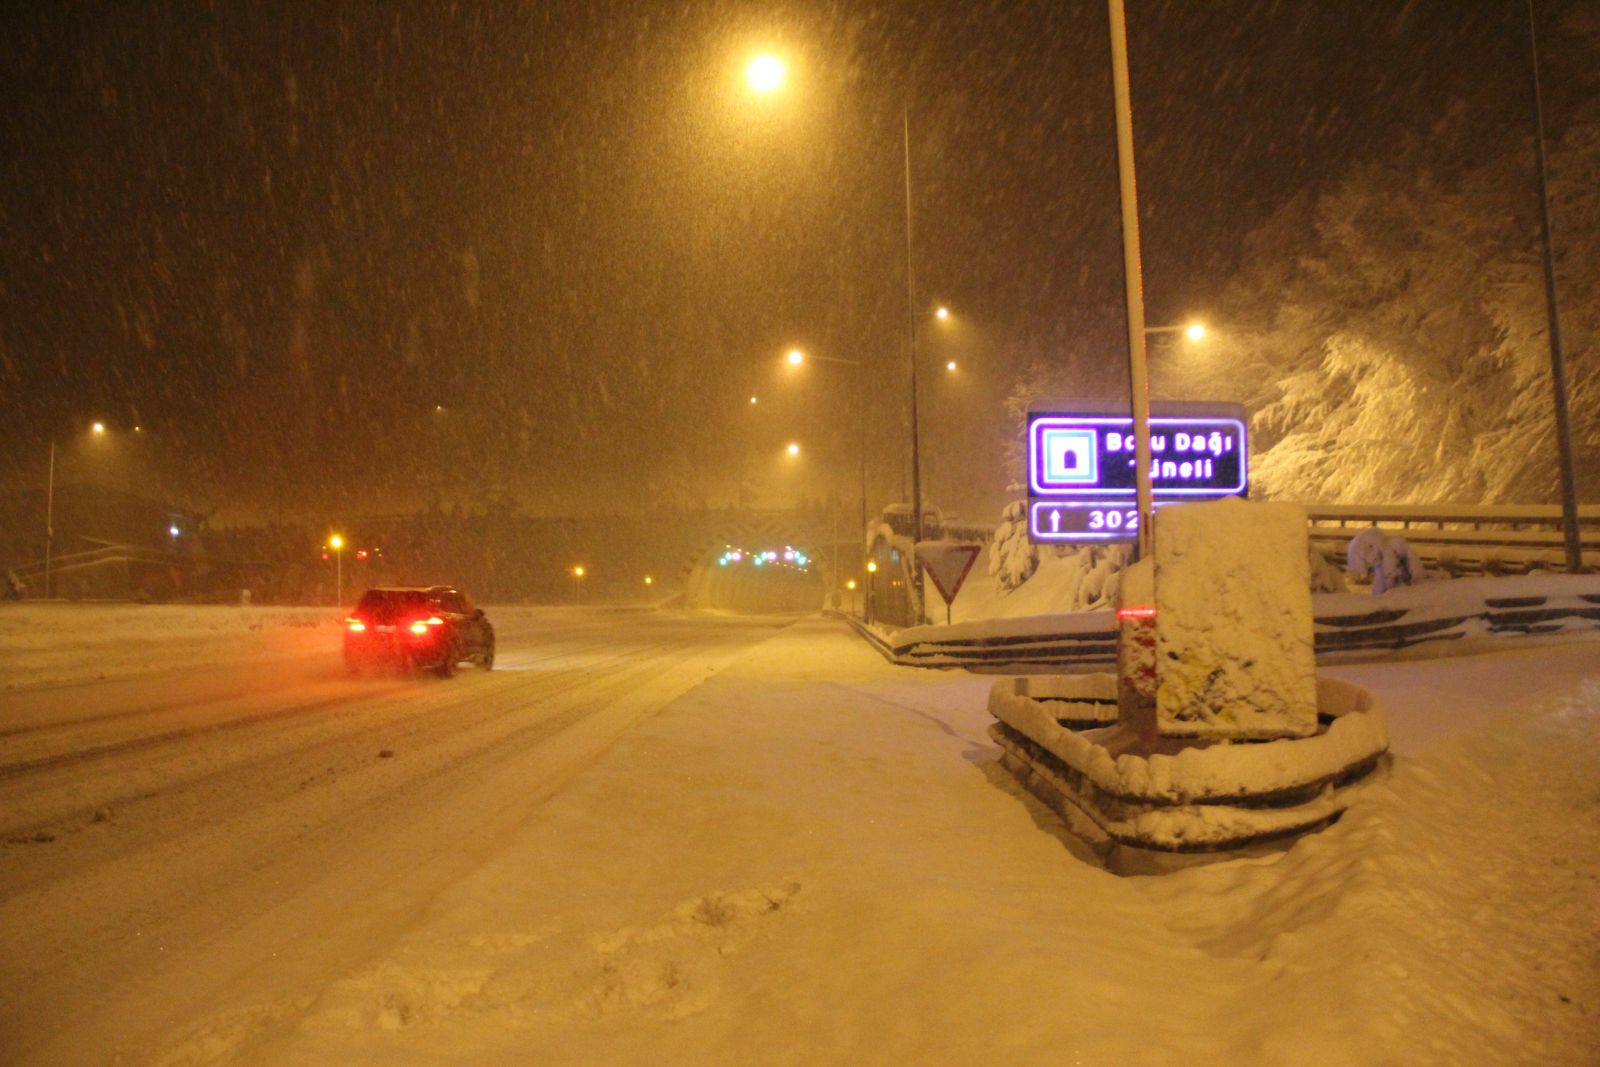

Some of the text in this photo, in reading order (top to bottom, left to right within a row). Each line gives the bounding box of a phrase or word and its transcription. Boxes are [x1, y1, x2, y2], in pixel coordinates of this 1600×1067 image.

[1106, 431, 1232, 456] Bou Dağı
[1128, 458, 1212, 478] üneli
[1089, 510, 1155, 529] 302
